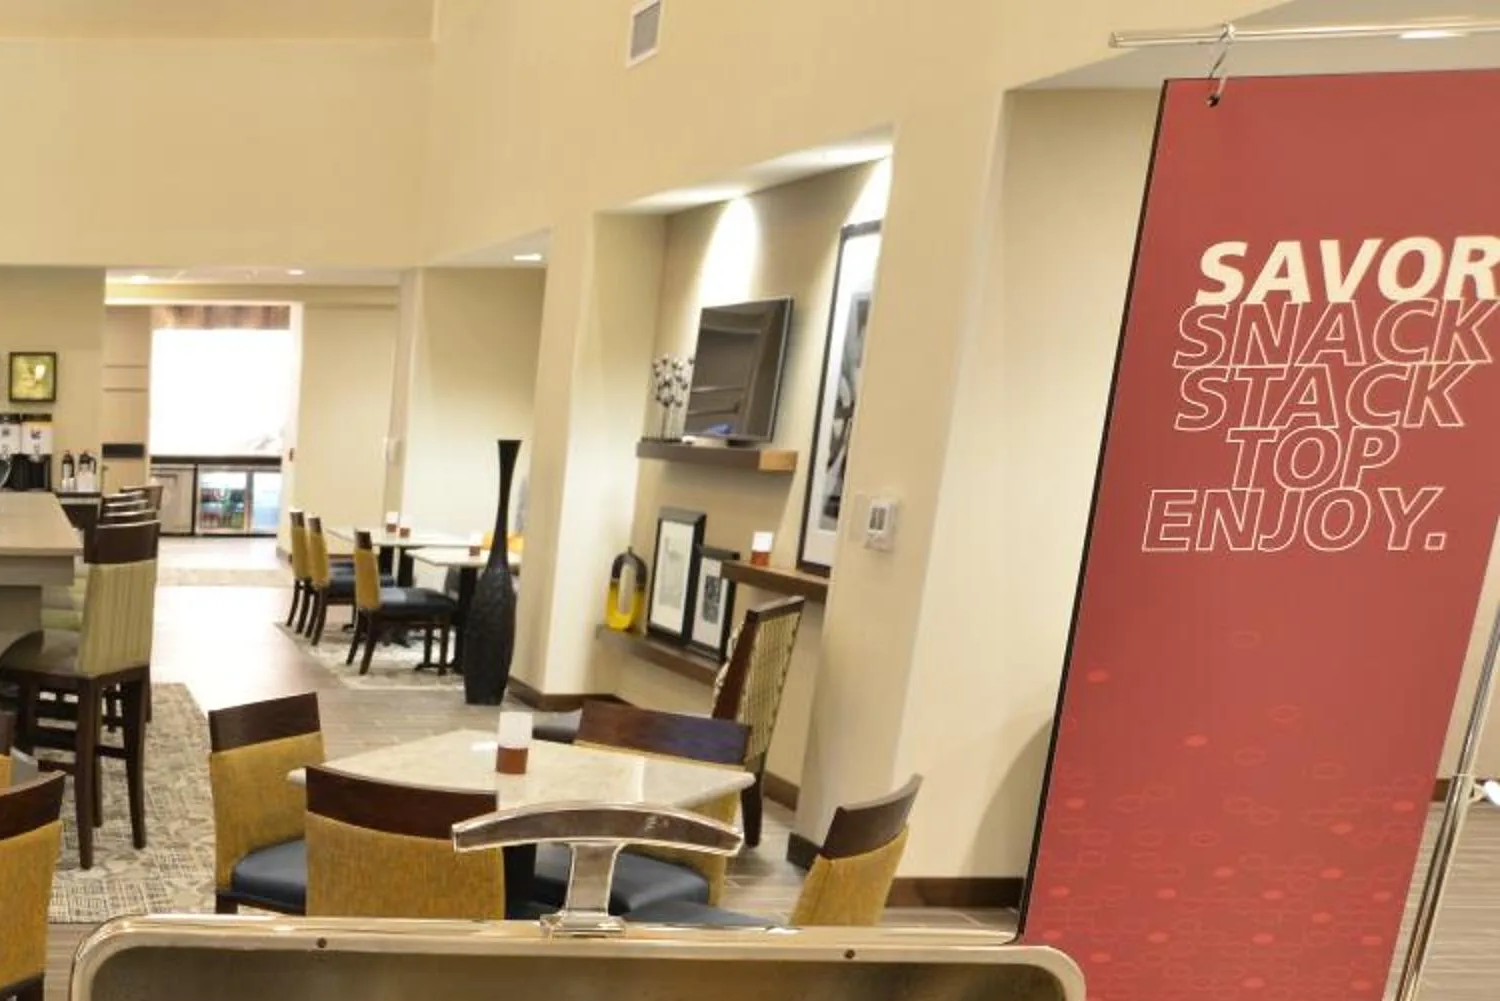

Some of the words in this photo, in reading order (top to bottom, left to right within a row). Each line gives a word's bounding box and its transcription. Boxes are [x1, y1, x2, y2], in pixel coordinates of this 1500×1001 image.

[1194, 234, 1500, 306] SAVOR
[1172, 299, 1499, 369] SNACK
[1174, 362, 1476, 431] STACK
[1225, 425, 1399, 491] TOP
[1142, 486, 1448, 552] ENJOY.
